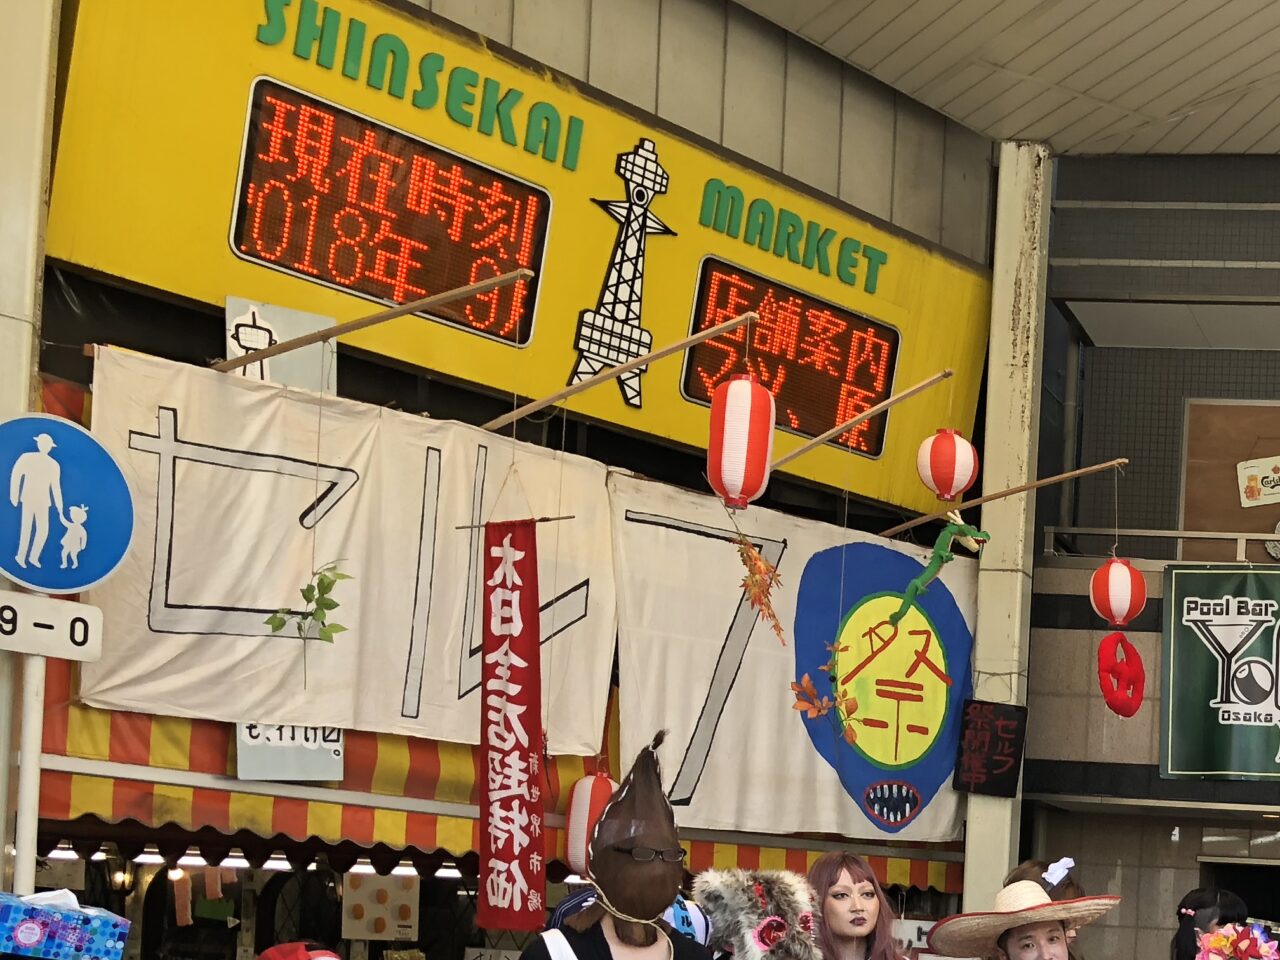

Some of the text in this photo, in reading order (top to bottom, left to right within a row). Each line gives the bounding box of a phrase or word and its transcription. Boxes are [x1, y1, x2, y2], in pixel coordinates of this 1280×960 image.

[257, 0, 584, 171] SHINSEKAI
[241, 179, 430, 303] 018年
[258, 95, 538, 267] 現在時刻
[699, 178, 887, 294] MARKET
[701, 271, 890, 391] 店舗案内
[1186, 598, 1276, 617] Pool Bar
[1220, 711, 1273, 723] Osaka
